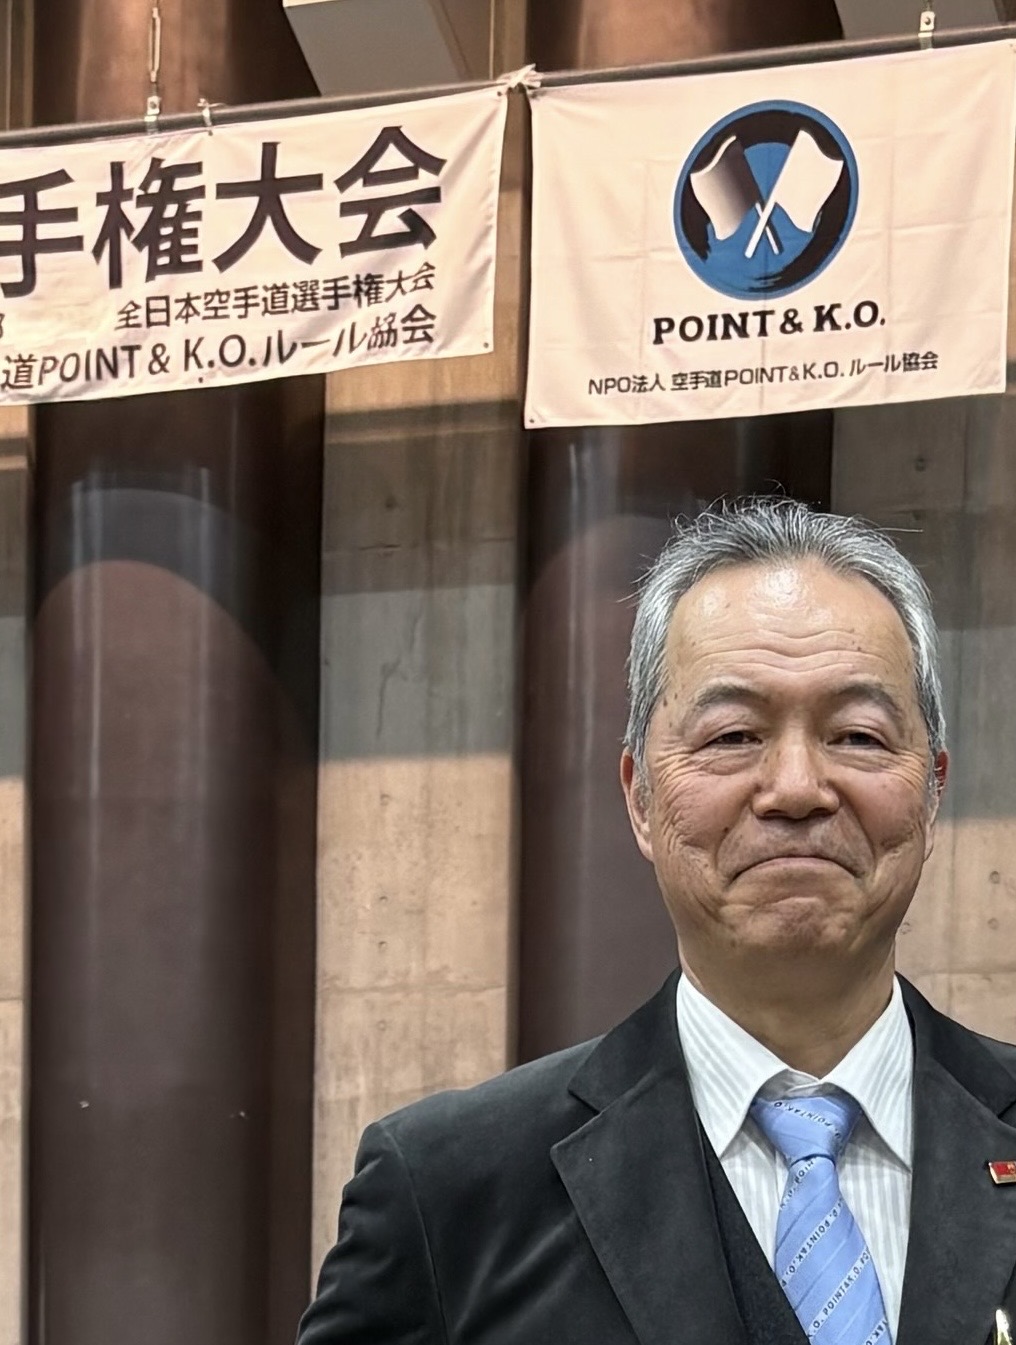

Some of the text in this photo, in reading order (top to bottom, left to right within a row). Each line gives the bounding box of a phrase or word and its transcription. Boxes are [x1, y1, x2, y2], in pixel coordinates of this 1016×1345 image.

[0, 125, 448, 298] 手権大会
[114, 261, 436, 331] 全日本空手道選手権大会
